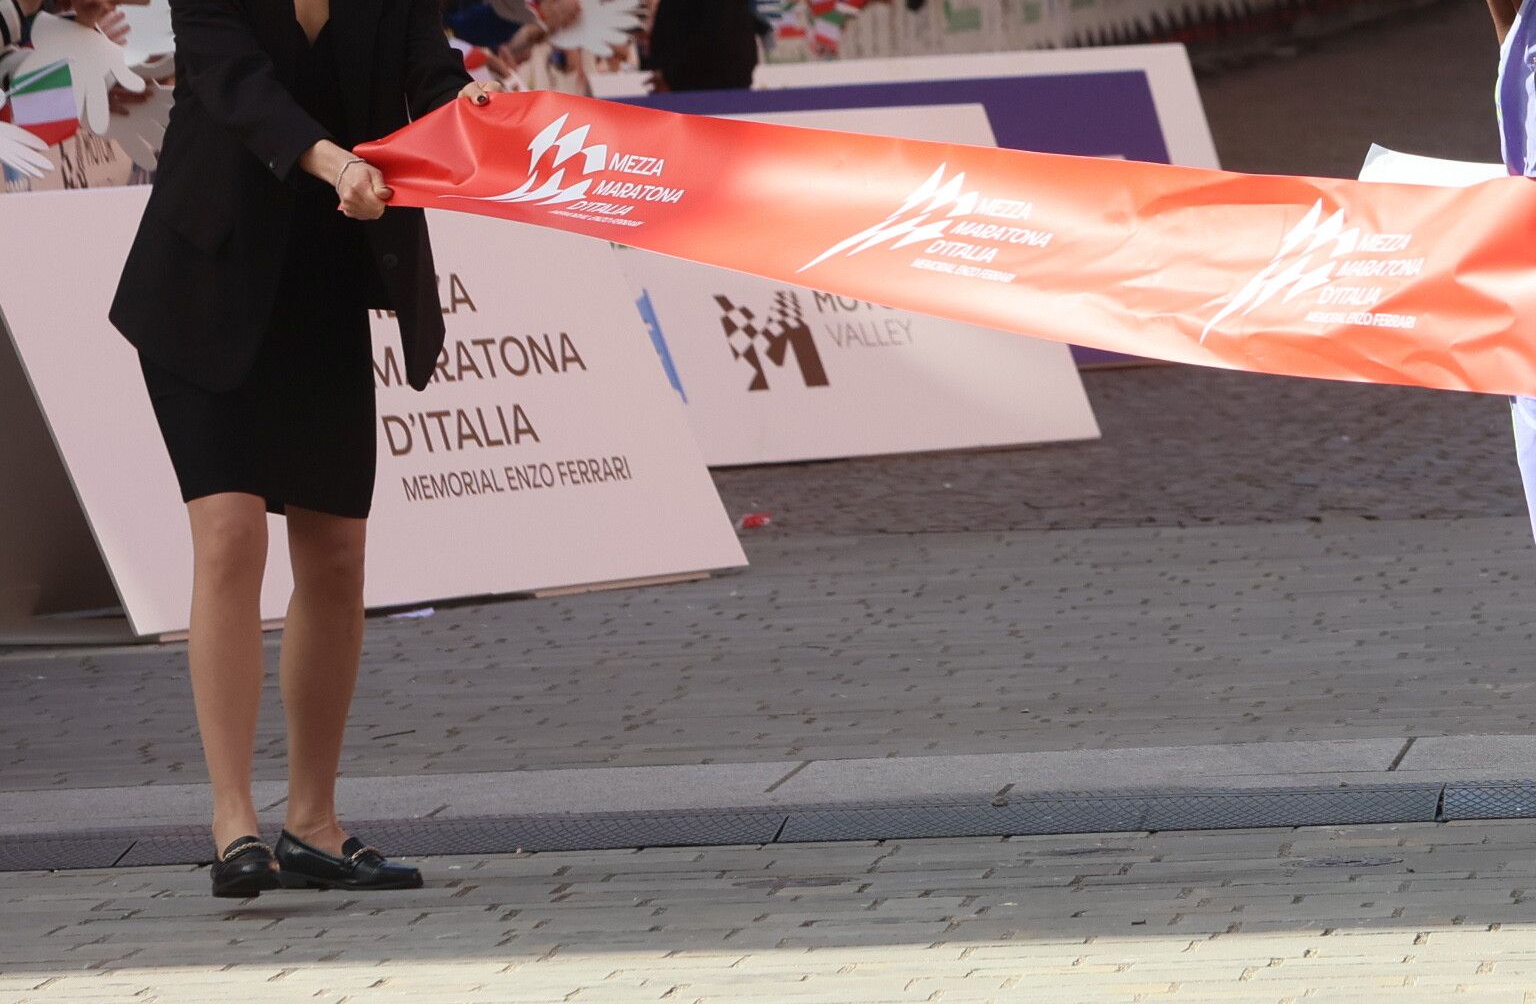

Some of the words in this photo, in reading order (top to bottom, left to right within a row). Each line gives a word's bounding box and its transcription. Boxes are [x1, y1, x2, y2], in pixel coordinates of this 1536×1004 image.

[608, 152, 665, 177] MEZZA
[592, 179, 685, 204] MARATONA
[973, 197, 1034, 221] MEZZA
[950, 220, 1055, 248] MARATONA
[1357, 233, 1413, 253] MEZZA
[1337, 256, 1425, 277] MARATONA
[825, 317, 913, 349] VALLEY
[372, 332, 588, 388] MRATONA
[382, 403, 541, 457] D'ITALIA
[402, 467, 505, 502] MEMORIAL
[505, 462, 556, 491] ENZO
[558, 455, 633, 486] FERRARI
